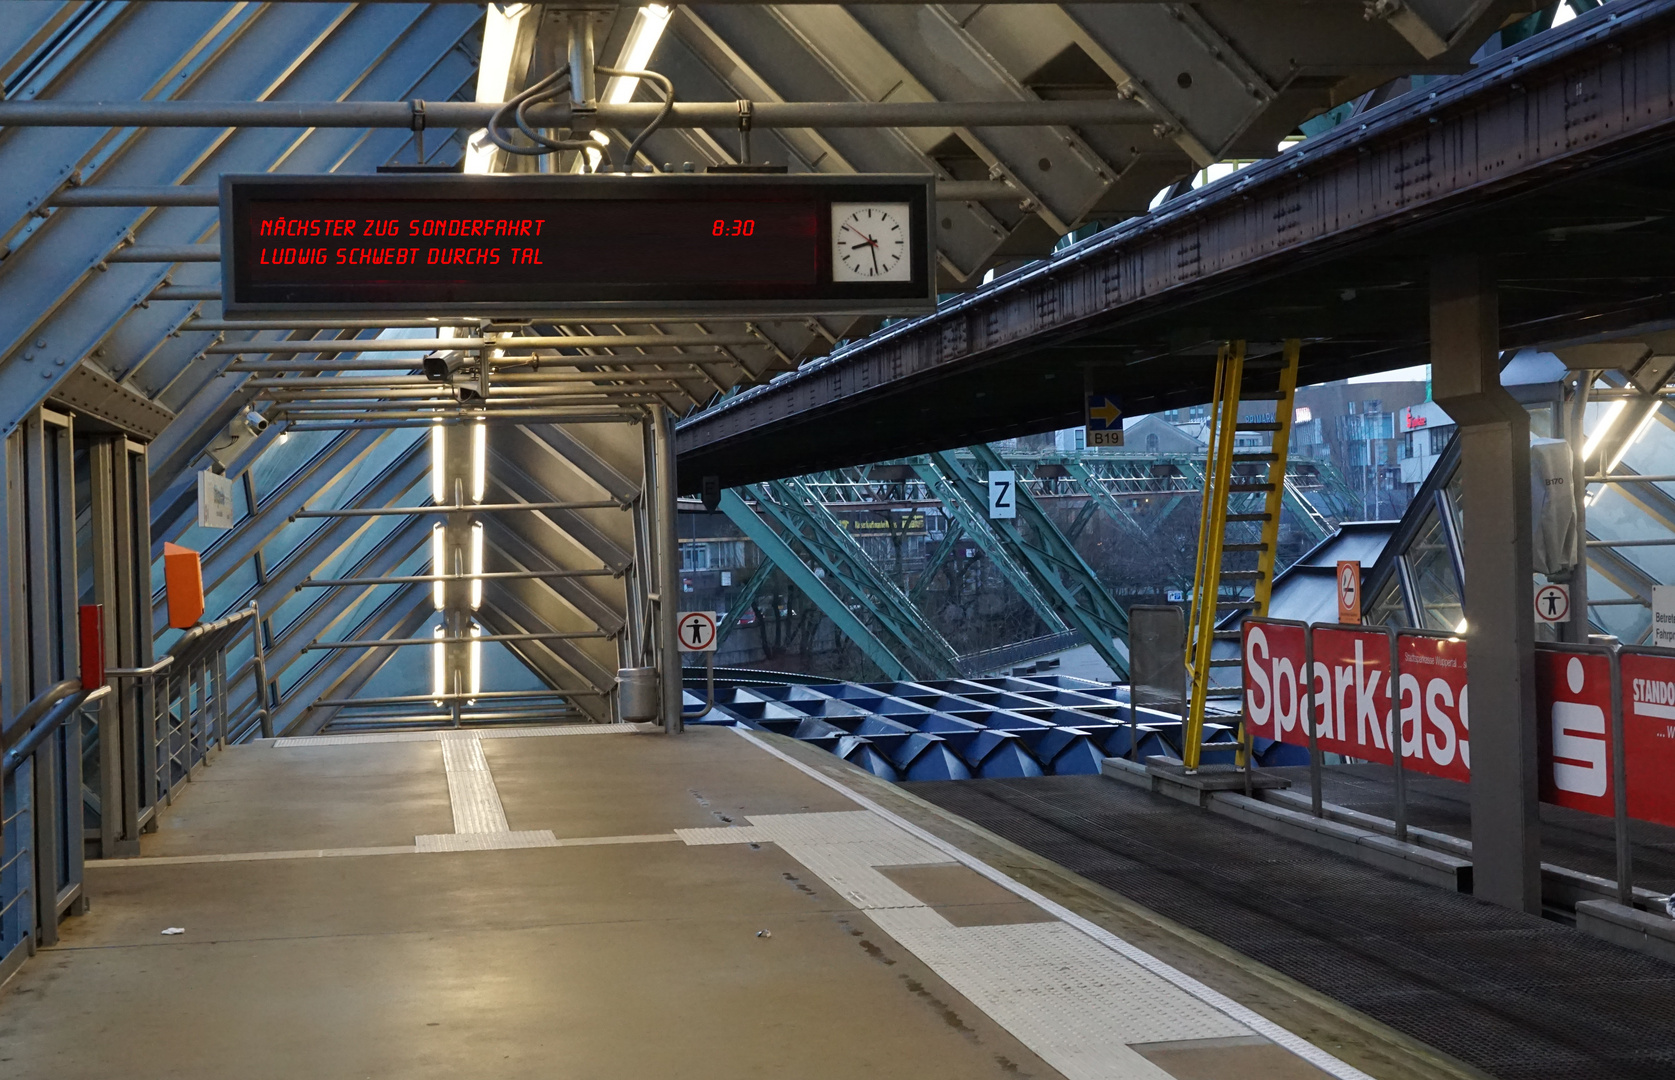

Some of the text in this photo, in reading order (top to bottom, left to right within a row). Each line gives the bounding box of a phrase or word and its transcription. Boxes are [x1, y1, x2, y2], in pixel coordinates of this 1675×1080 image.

[260, 217, 546, 237] NÄCHSTER ZUG SONDERFAHRT
[711, 219, 755, 237] 8:30
[260, 248, 544, 265] LUDWIG SCHWEBT DURCHS TAL
[1094, 432, 1119, 444] B19
[1545, 477, 1564, 486] B170
[994, 481, 1010, 508] Z
[1632, 677, 1675, 706] STANDO
